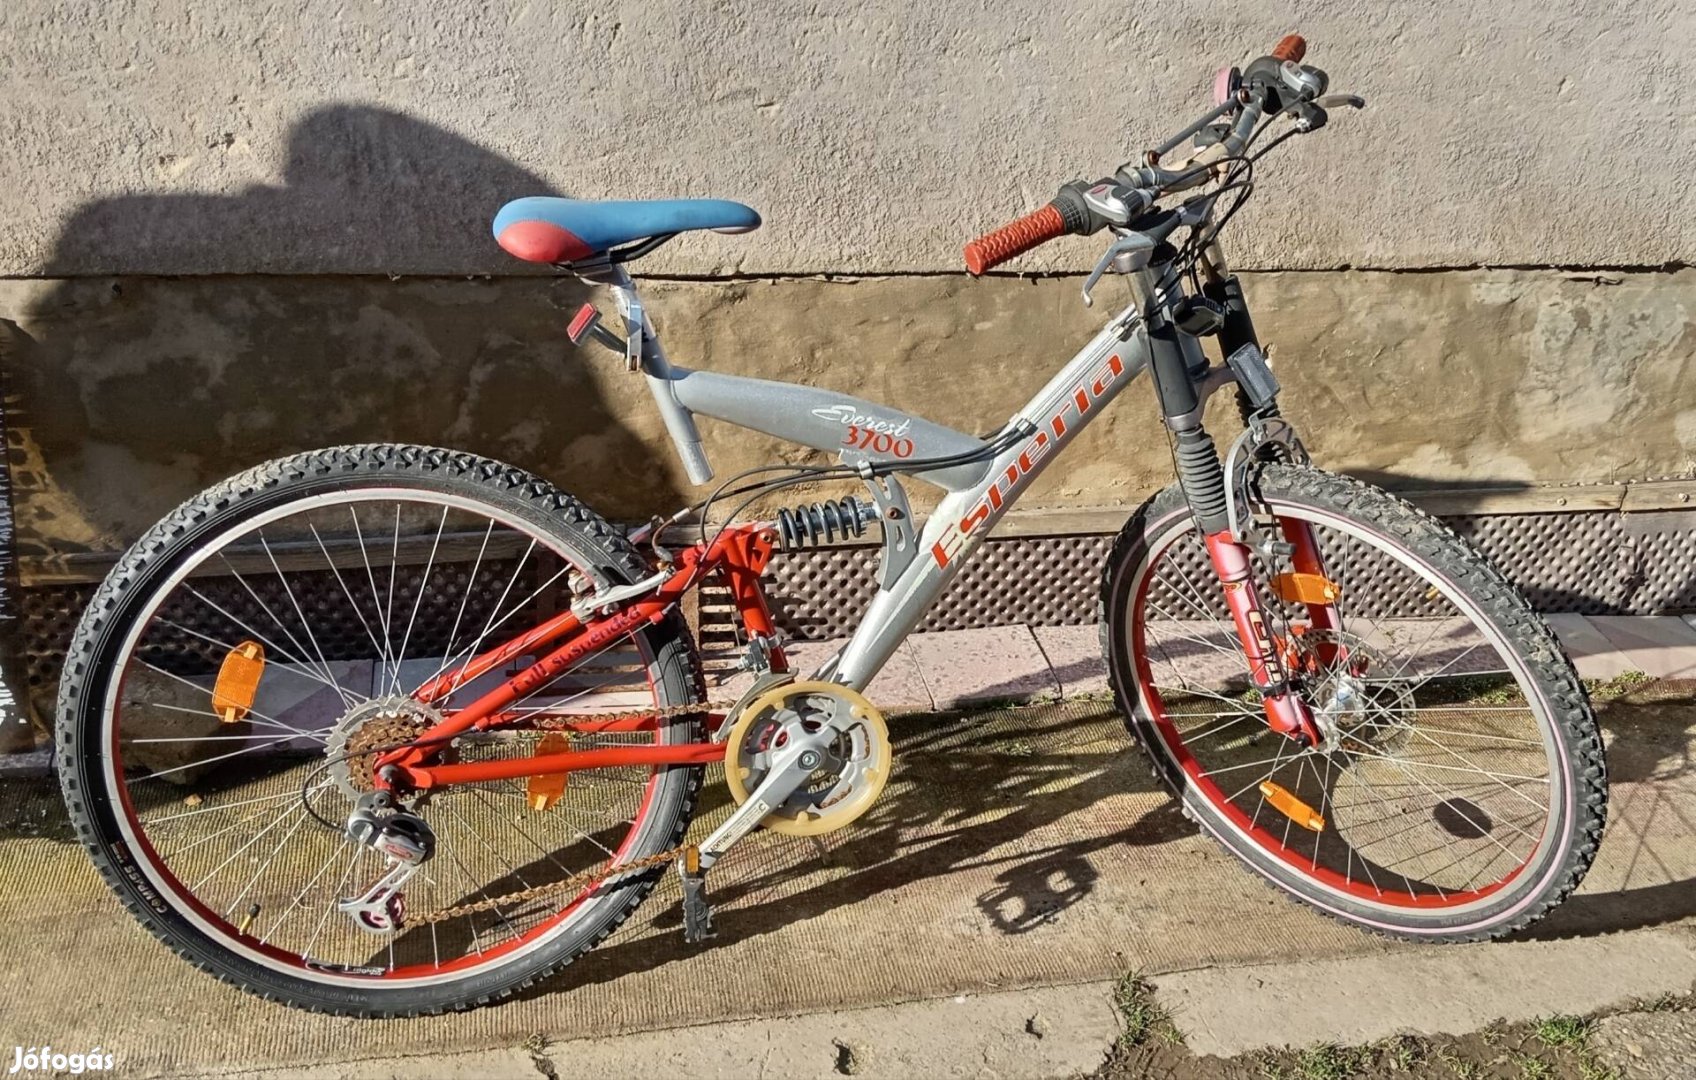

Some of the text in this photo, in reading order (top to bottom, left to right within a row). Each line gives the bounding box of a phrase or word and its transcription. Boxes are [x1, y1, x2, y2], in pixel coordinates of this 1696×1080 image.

[811, 404, 912, 438] Everest
[841, 424, 915, 459] 3700
[930, 353, 1125, 571] Esperia
